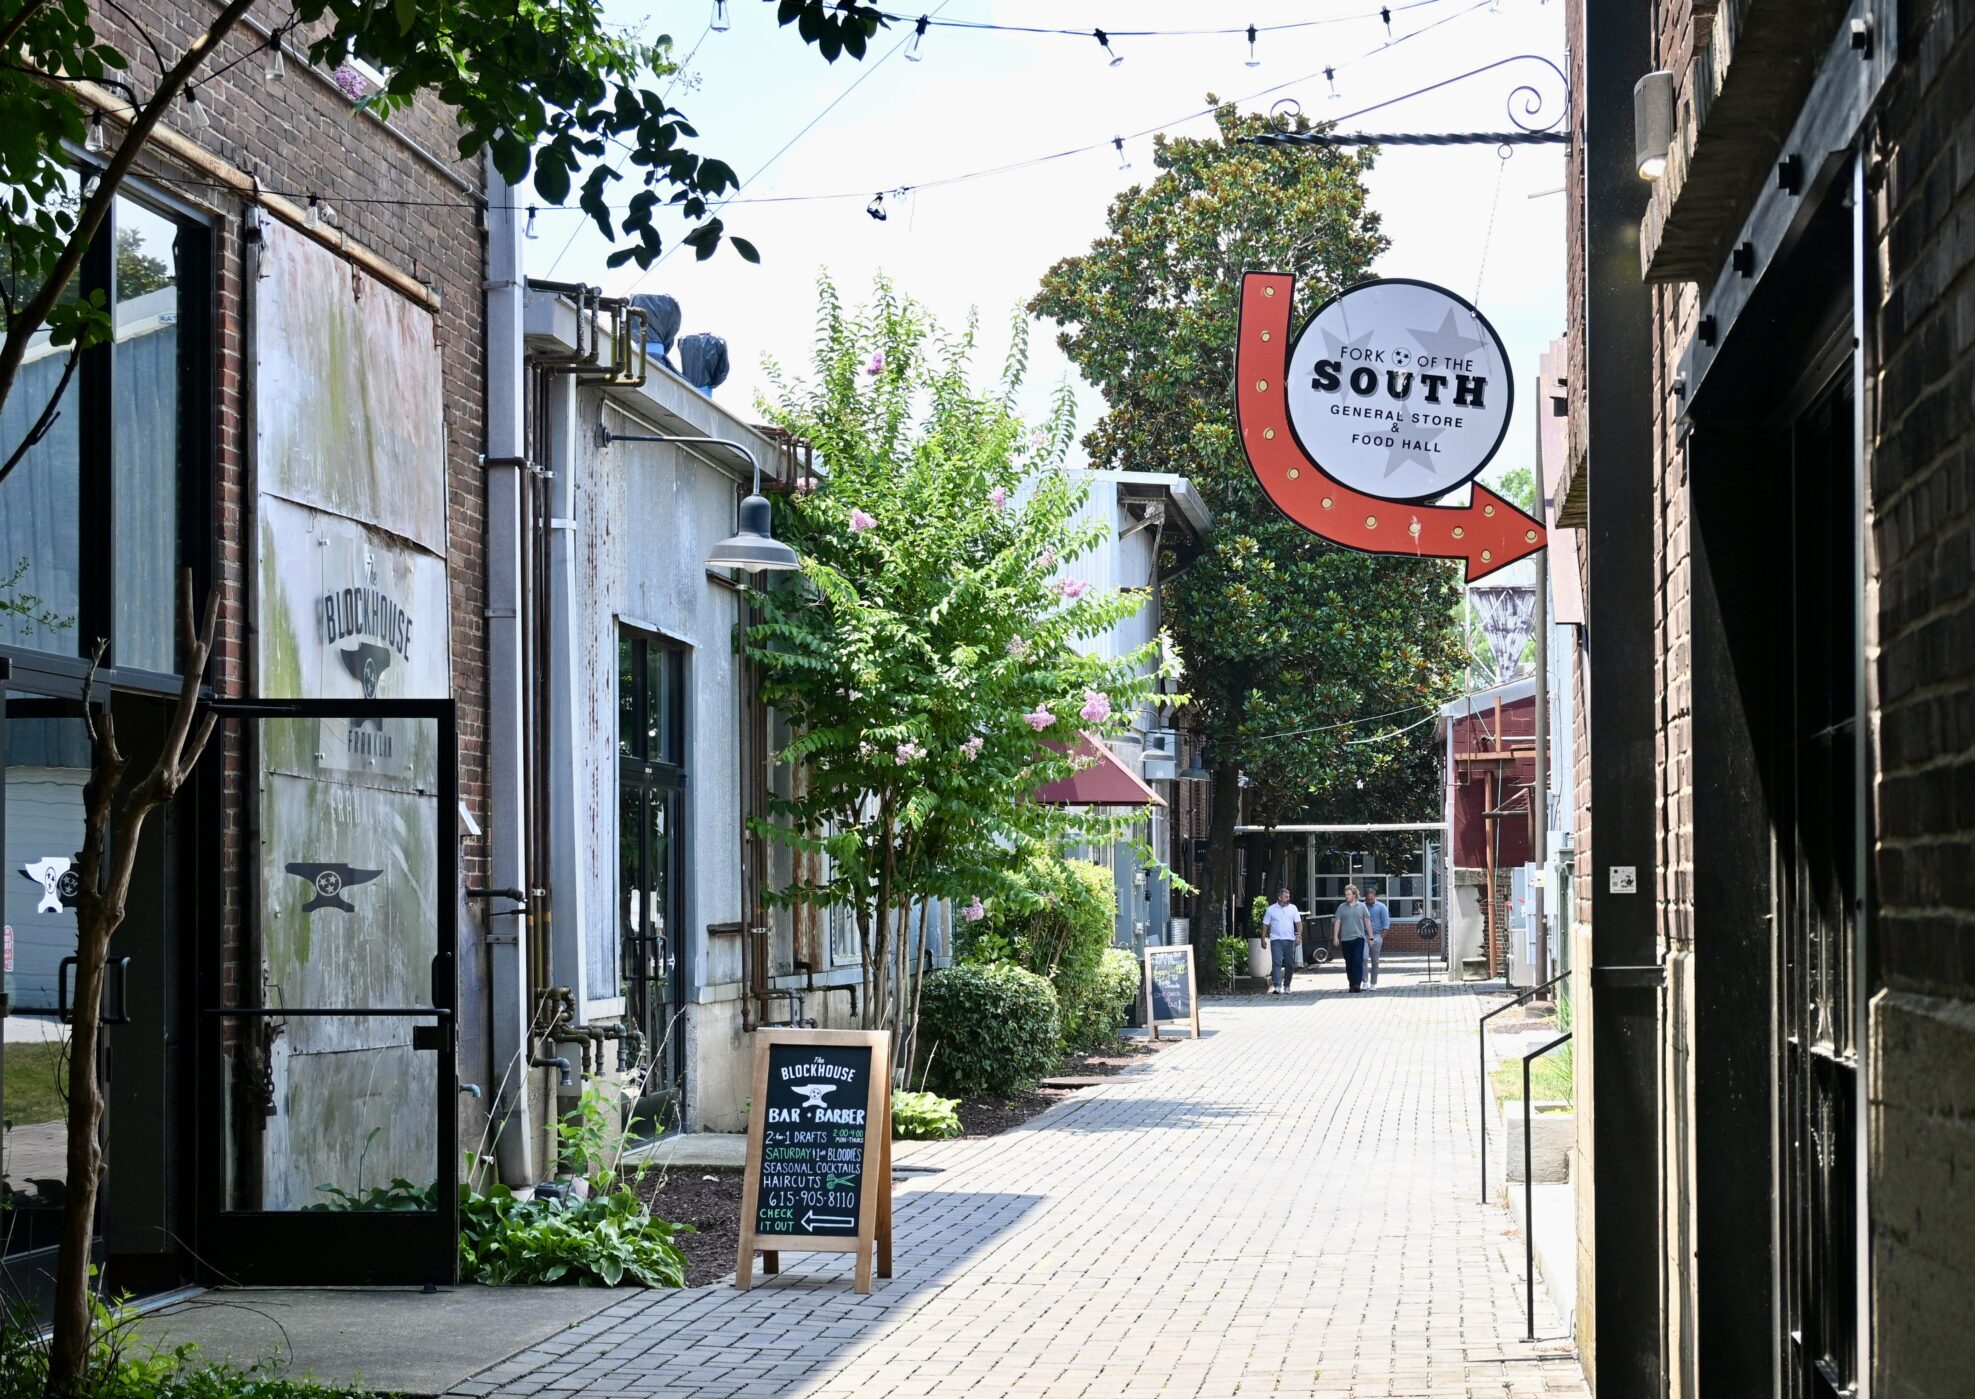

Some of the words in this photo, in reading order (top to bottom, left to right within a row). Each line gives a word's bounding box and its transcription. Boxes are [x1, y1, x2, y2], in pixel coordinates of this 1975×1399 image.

[1340, 346, 1386, 364] FORK
[1416, 355, 1438, 368] OF
[1444, 357, 1474, 373] THE
[1311, 359, 1488, 409] SOUTH
[1330, 404, 1404, 422] GENERAL
[1411, 412, 1463, 428] STORE
[1390, 422, 1400, 433] &
[1351, 433, 1394, 448] FOOD
[1402, 438, 1442, 453] HALL
[324, 587, 413, 662] BLOCKHOUSE
[348, 729, 393, 758] FRANKLIN
[780, 1063, 856, 1082] BLOCKHOUSE
[768, 1107, 800, 1123] BAR
[815, 1108, 865, 1125] BARBER
[794, 1131, 827, 1143] DRAFTS
[765, 1147, 811, 1160] SATURDAY
[827, 1147, 862, 1162] BLOODIES
[763, 1162, 814, 1174] SEASONAL
[816, 1162, 861, 1175] COCKTAILS
[763, 1175, 822, 1188] HAIRCUTS
[768, 1190, 856, 1208] 615-905-8110
[759, 1208, 794, 1219] CHECK
[760, 1221, 772, 1231] IT
[774, 1221, 795, 1232] OUT
